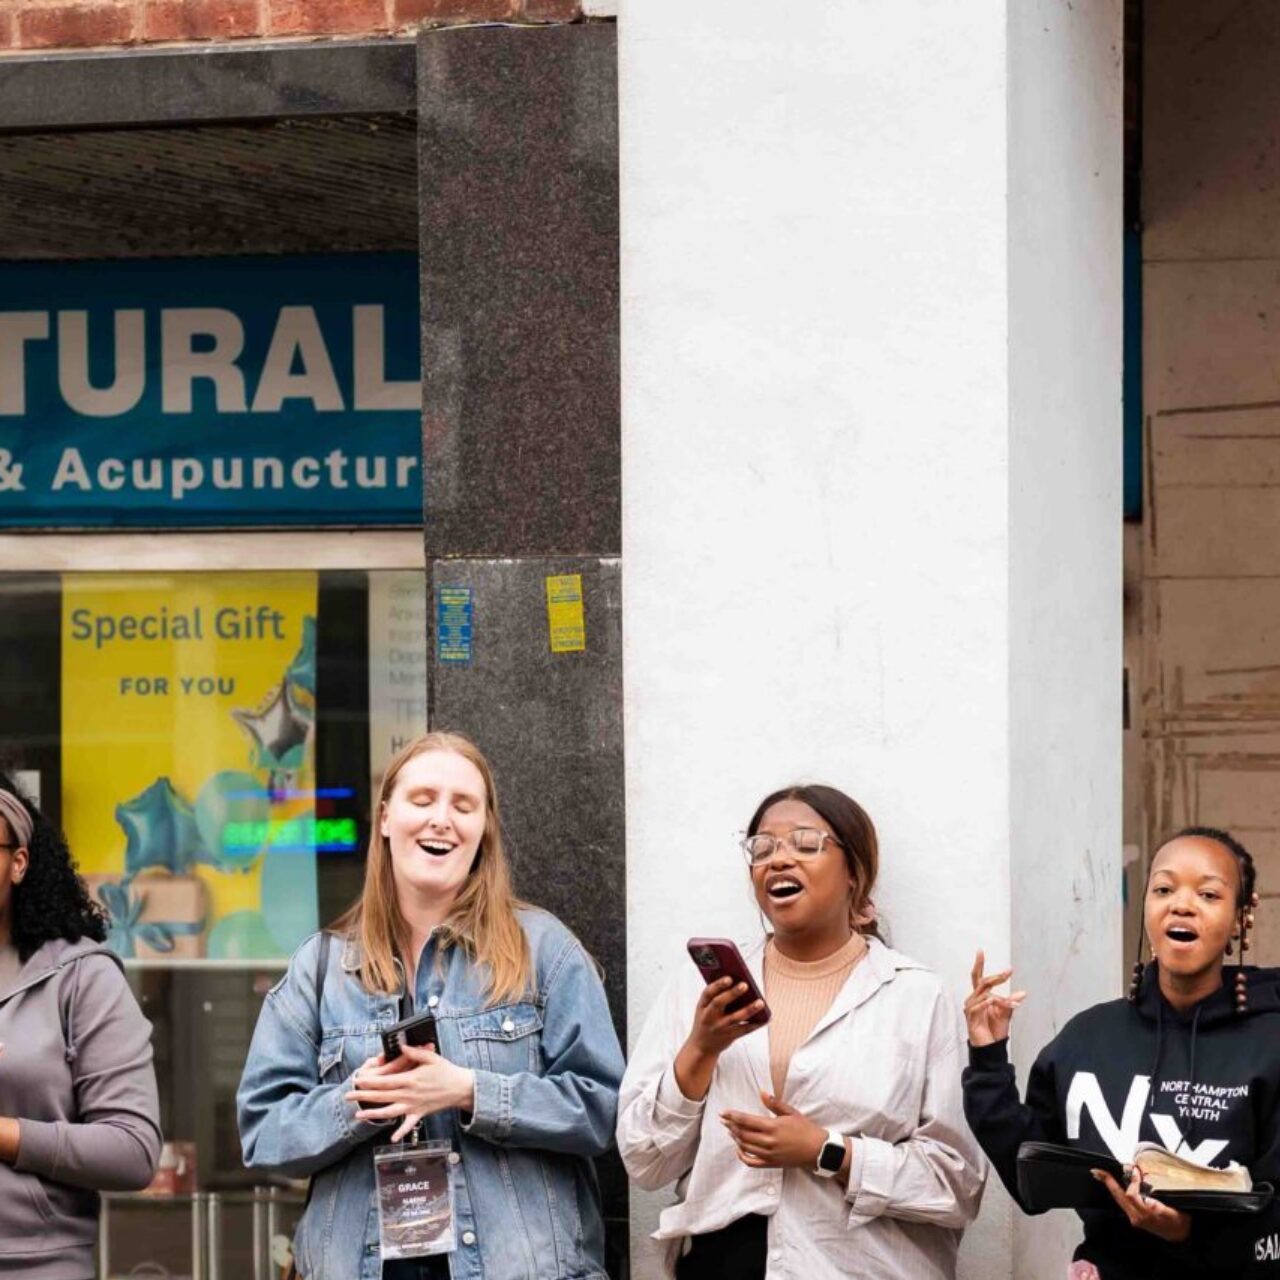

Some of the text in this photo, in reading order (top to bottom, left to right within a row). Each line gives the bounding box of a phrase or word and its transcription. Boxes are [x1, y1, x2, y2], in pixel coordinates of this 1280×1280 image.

[71, 606, 285, 649] Special Gift
[120, 677, 235, 696] FOR YOU
[1160, 1081, 1249, 1098] NORTHAMPTON
[1175, 1094, 1229, 1110] CENTRAL
[1179, 1107, 1220, 1122] YOUTH
[398, 1181, 430, 1193] GRACE
